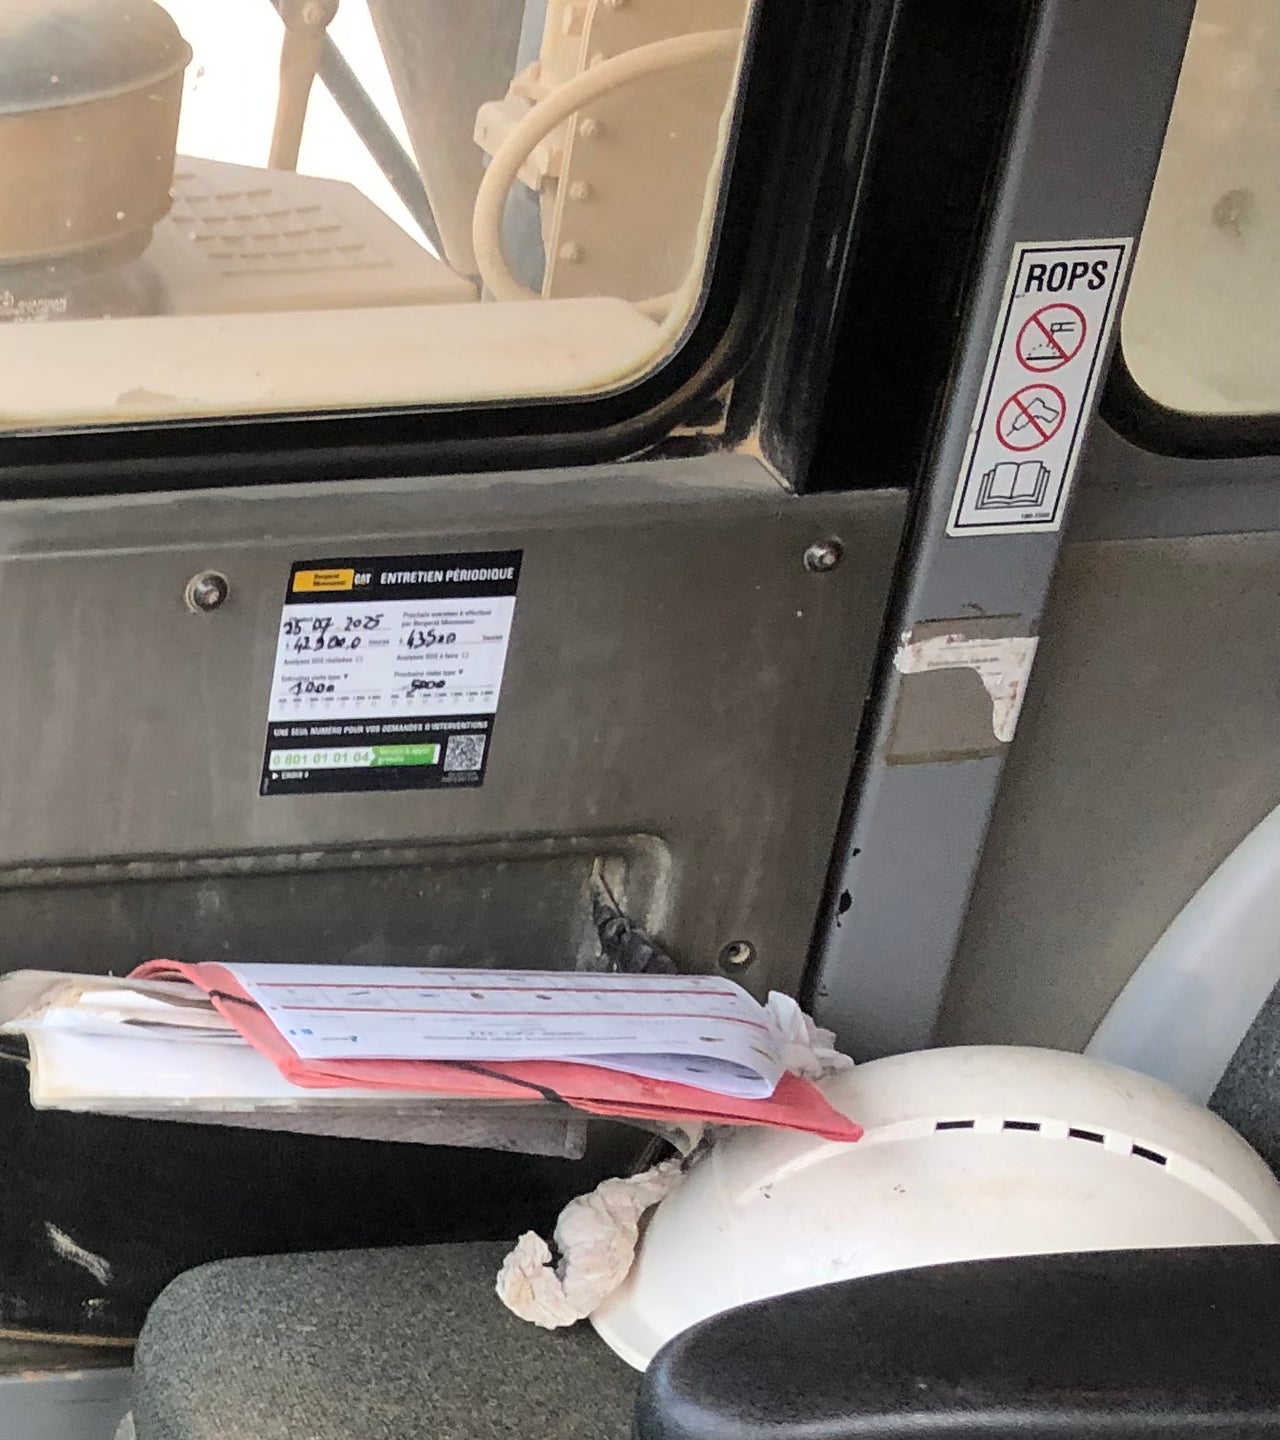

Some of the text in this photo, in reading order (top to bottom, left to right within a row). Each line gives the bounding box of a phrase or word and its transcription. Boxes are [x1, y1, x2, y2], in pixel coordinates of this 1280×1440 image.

[1024, 260, 1109, 293] ROPS
[380, 567, 515, 585] ENTRETIEN PÉRIODIQUE
